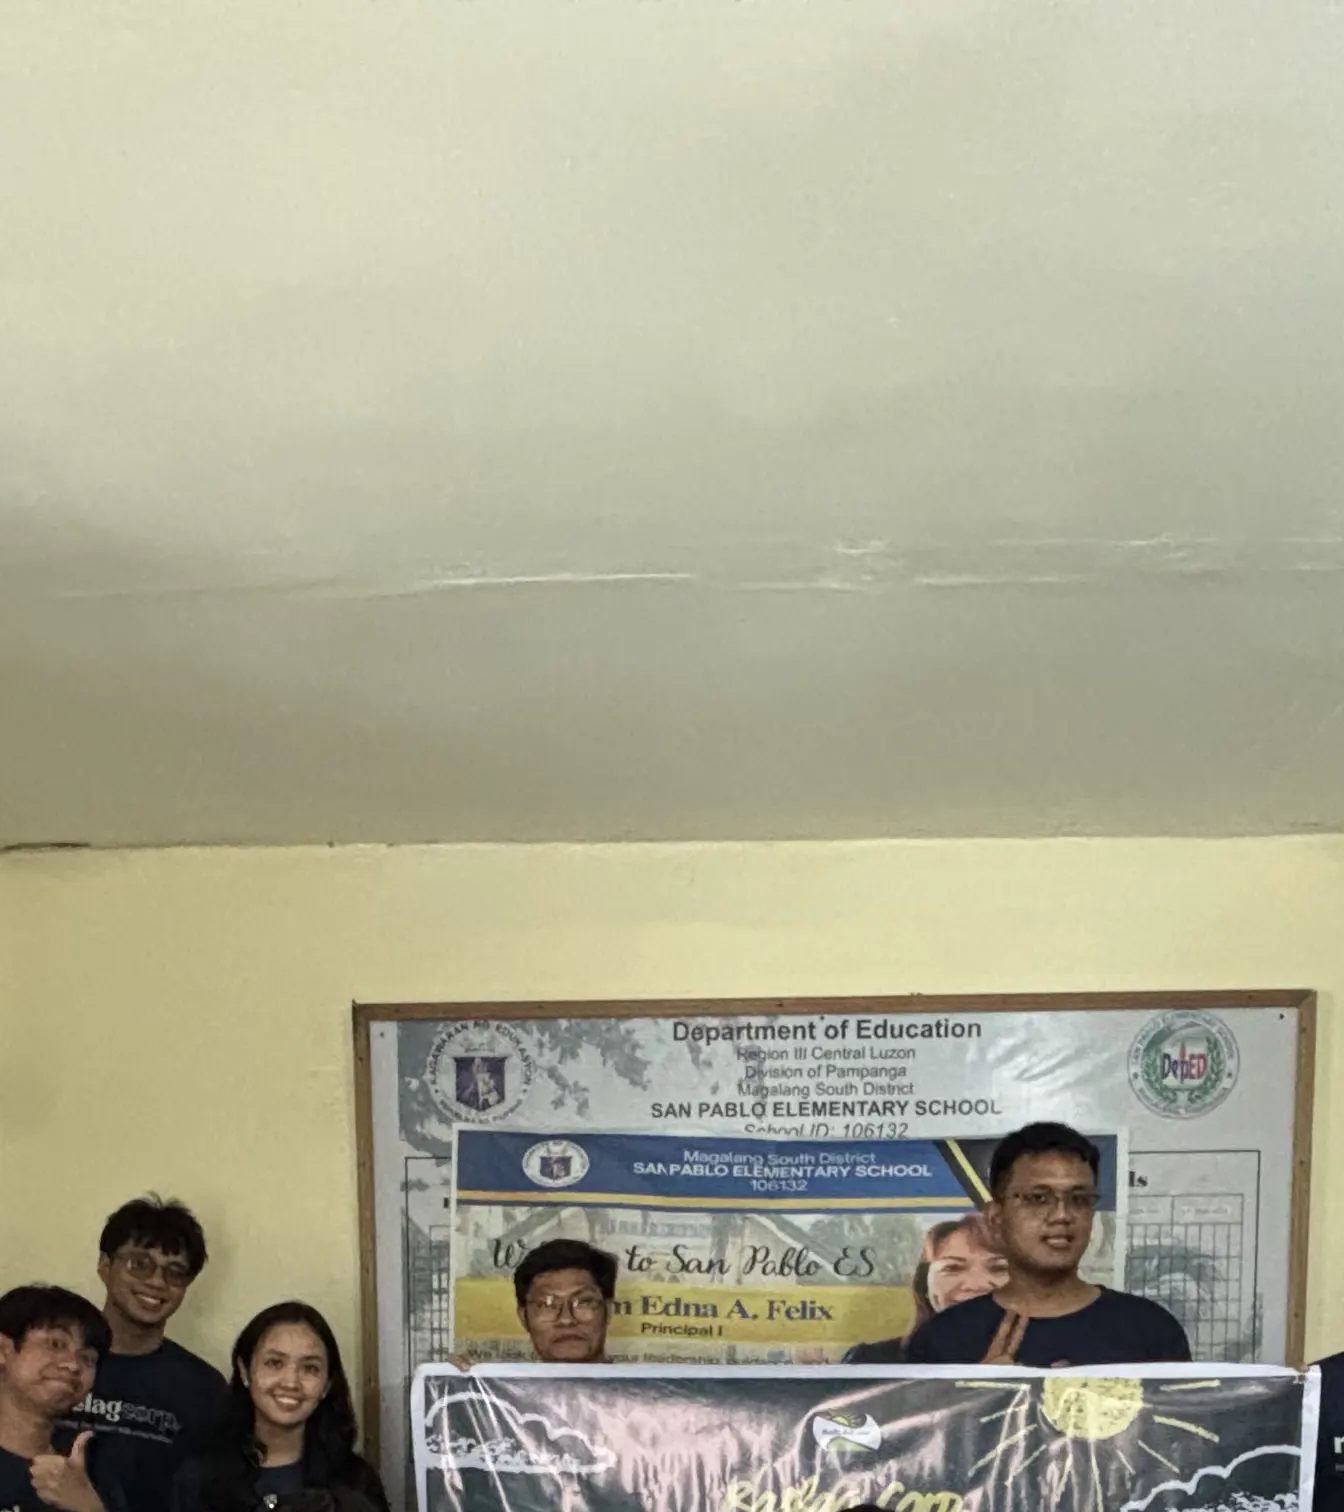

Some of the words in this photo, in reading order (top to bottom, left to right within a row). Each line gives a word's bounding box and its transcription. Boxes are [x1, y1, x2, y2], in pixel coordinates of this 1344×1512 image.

[673, 1021, 815, 1044] Department
[824, 1020, 850, 1040] of
[857, 1019, 982, 1039] Education
[737, 1048, 789, 1063] Region
[794, 1047, 807, 1060] III
[812, 1047, 865, 1060] Central
[870, 1047, 916, 1060] Luzon
[744, 1065, 802, 1079] Division
[807, 1064, 822, 1078] of
[826, 1065, 907, 1081] Pampanga
[738, 1083, 810, 1099] Magalang
[815, 1083, 858, 1096] South
[863, 1082, 914, 1096] District
[651, 1103, 692, 1118] SAN
[699, 1102, 767, 1118] PABLO
[773, 1101, 908, 1117] ELEMENTARY
[915, 1099, 1001, 1115] SCHOOL
[843, 1122, 909, 1138] 106132
[684, 1150, 761, 1167] Magalang
[768, 1153, 816, 1165] South
[819, 1152, 876, 1164] District
[670, 1163, 728, 1177] PABLO
[732, 1164, 851, 1178] ELEMENTARY
[855, 1164, 932, 1177] SCHOOL
[752, 1179, 808, 1192] 106132
[625, 1248, 658, 1273] to
[665, 1243, 731, 1275] San
[741, 1244, 823, 1277] Pablo
[833, 1244, 877, 1277] ES
[641, 1296, 718, 1318] Edna
[725, 1298, 759, 1319] A.
[766, 1298, 834, 1321] Felix
[641, 1322, 714, 1338] Principal
[717, 1325, 724, 1338] I
